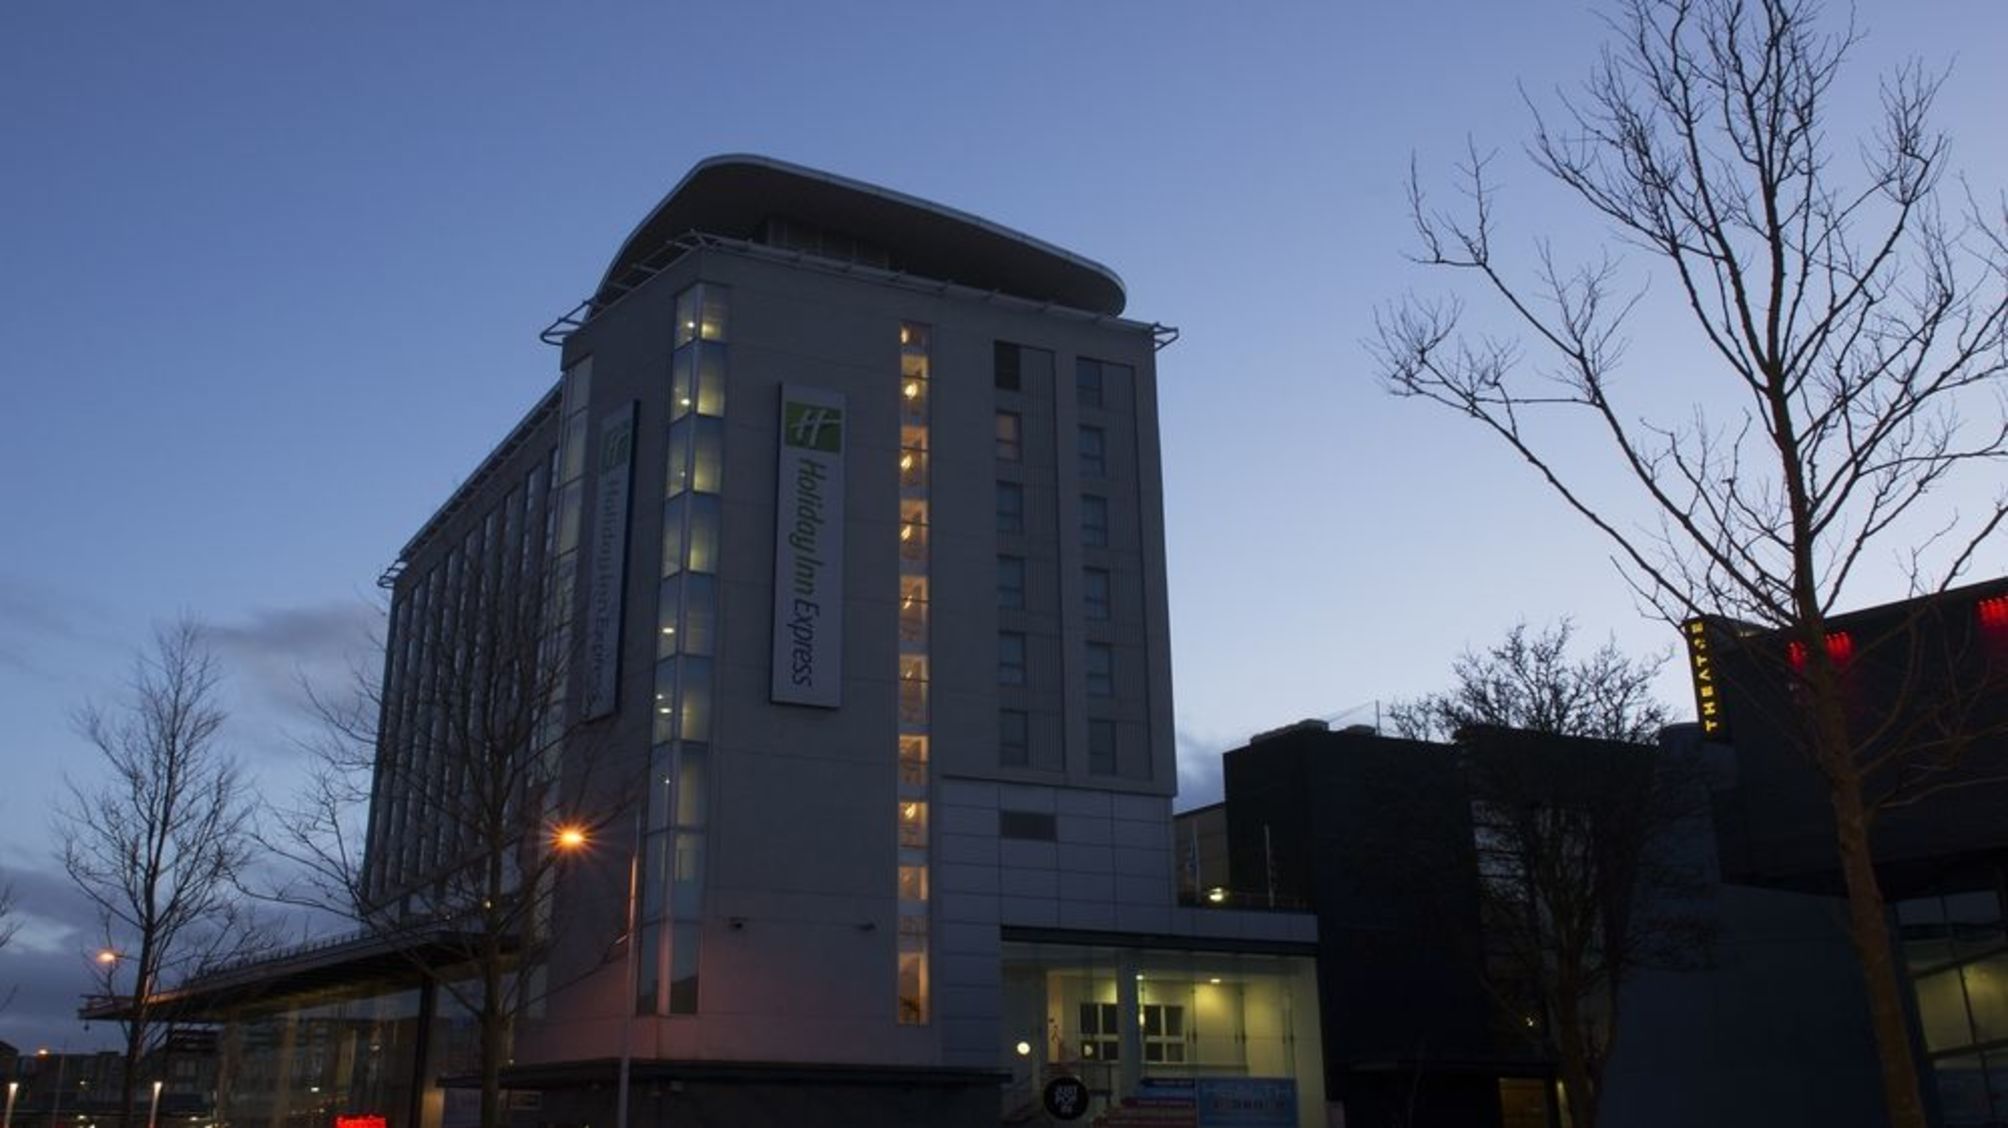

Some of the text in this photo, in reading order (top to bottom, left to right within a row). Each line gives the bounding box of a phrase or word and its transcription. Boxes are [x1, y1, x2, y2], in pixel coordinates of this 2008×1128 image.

[787, 459, 827, 687] Holiday Inn Express
[1691, 622, 1718, 731] THEATRE
